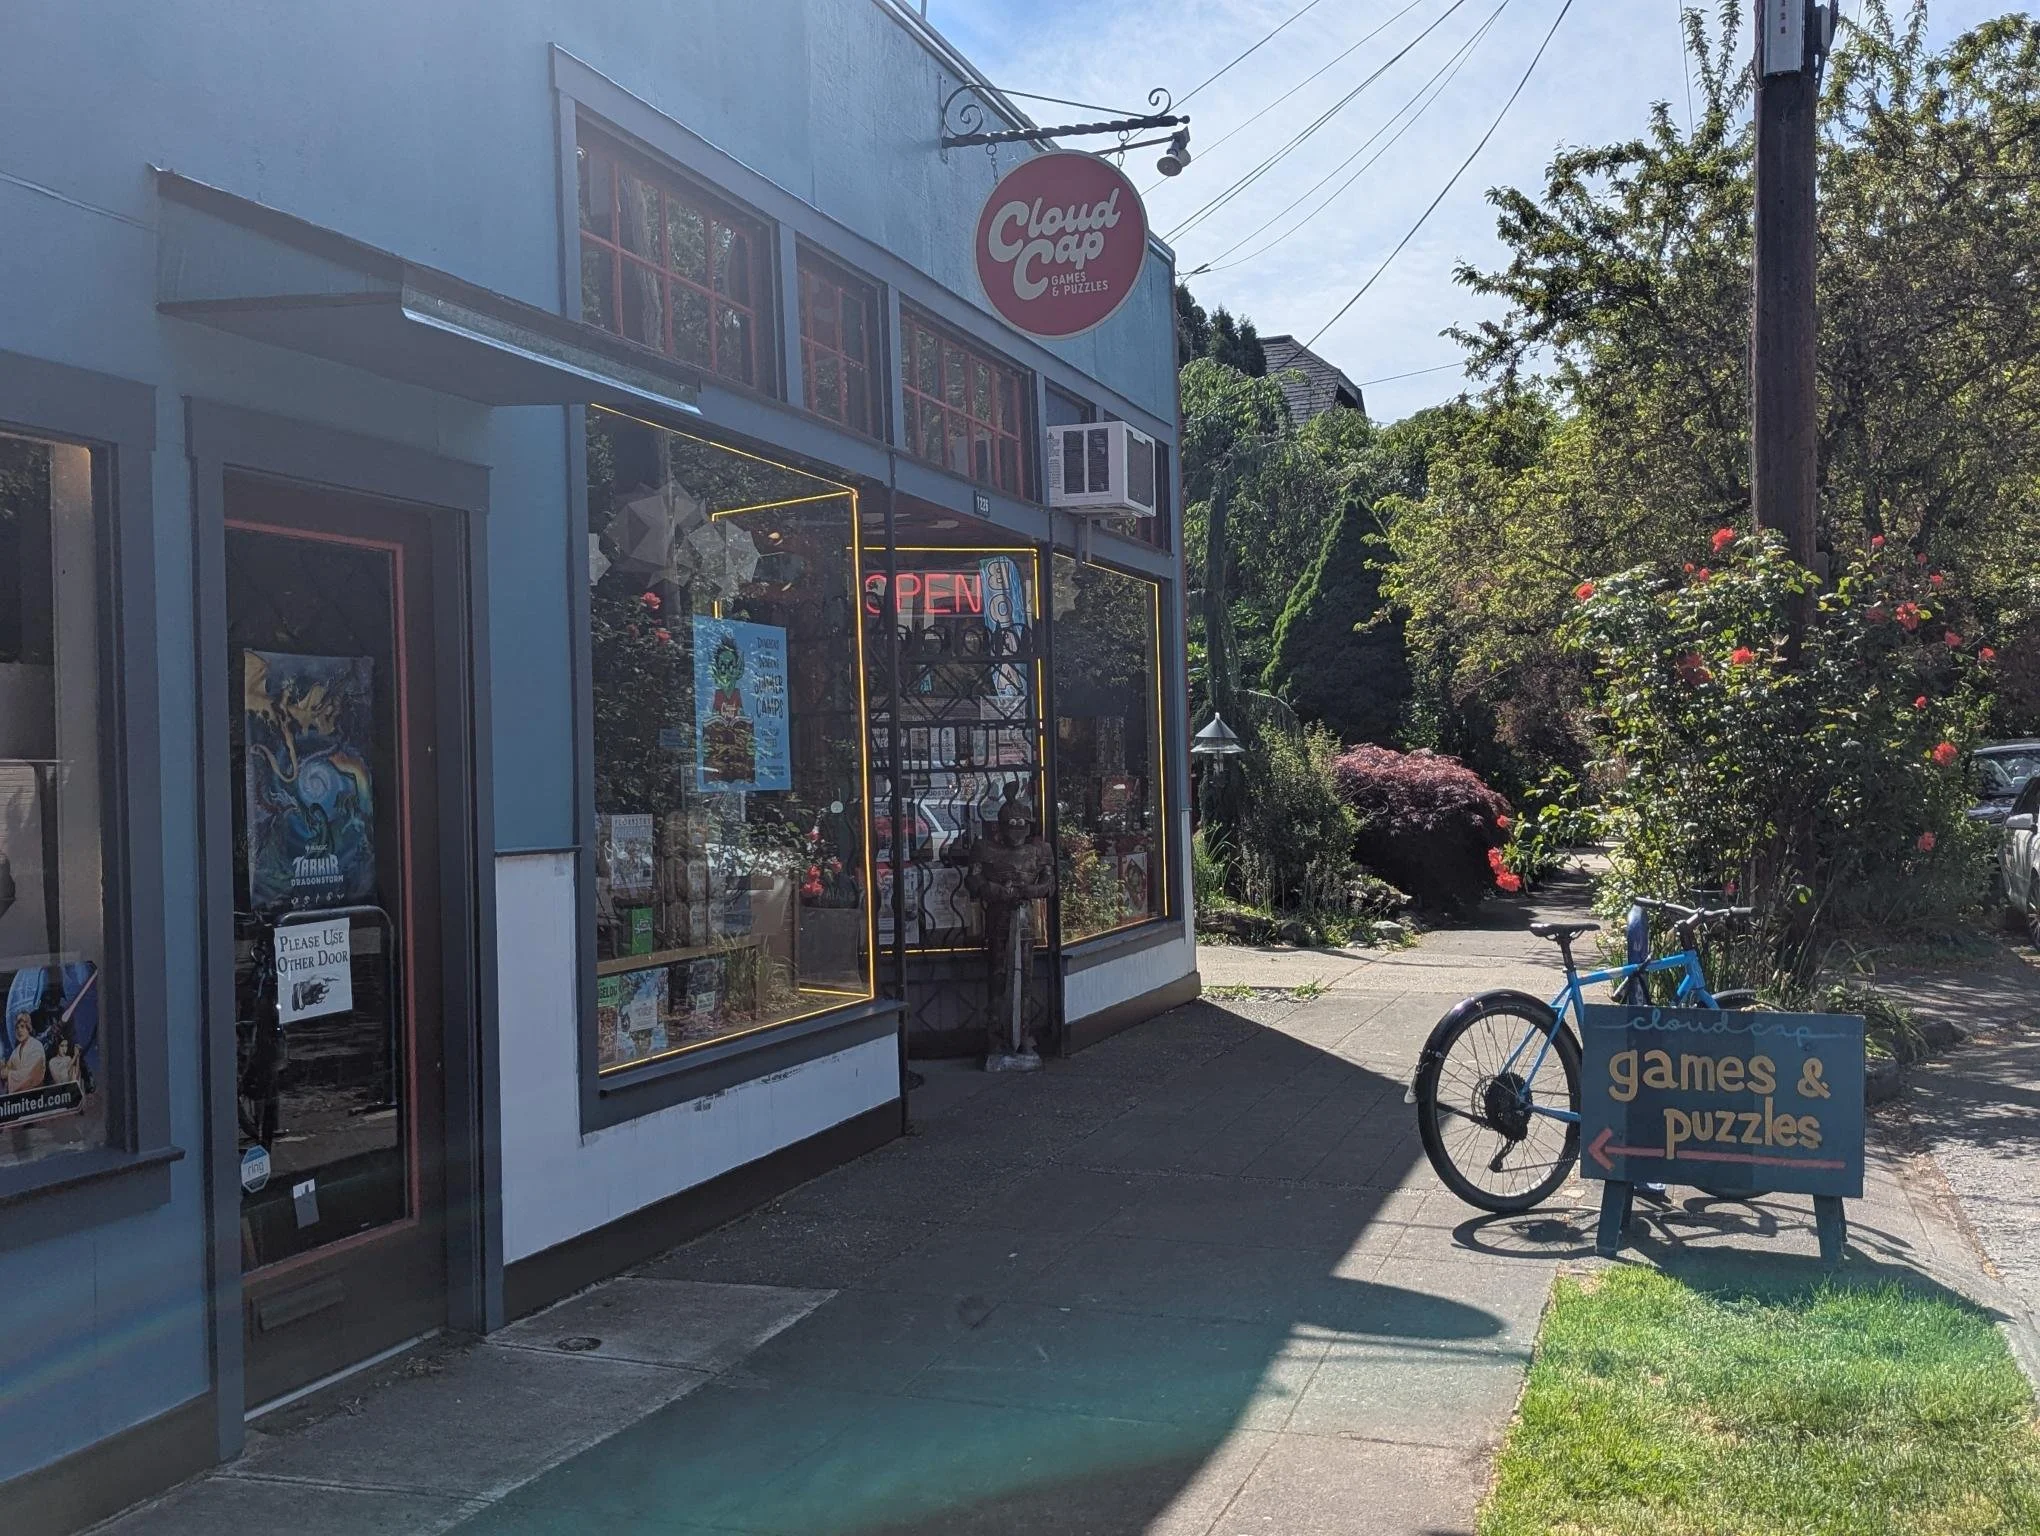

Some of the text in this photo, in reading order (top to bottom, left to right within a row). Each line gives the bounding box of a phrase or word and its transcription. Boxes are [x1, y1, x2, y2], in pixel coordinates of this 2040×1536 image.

[988, 188, 1121, 262] Cloud
[1013, 230, 1105, 300] Cap
[1051, 271, 1087, 286] GAMES
[1052, 280, 1109, 297] & PUZZLES
[864, 572, 983, 614] OPEN
[756, 697, 784, 719] CAMPS
[292, 854, 339, 878] TARKIR
[290, 874, 344, 887] DRAGONSTORM
[279, 929, 344, 953] PLEASE USE
[277, 950, 348, 973] OTHER DOOR
[1616, 1010, 1824, 1047] cloud cap
[1608, 1049, 1832, 1101] games &
[1663, 1097, 1823, 1160] puzzles
[247, 1161, 264, 1176] ring
